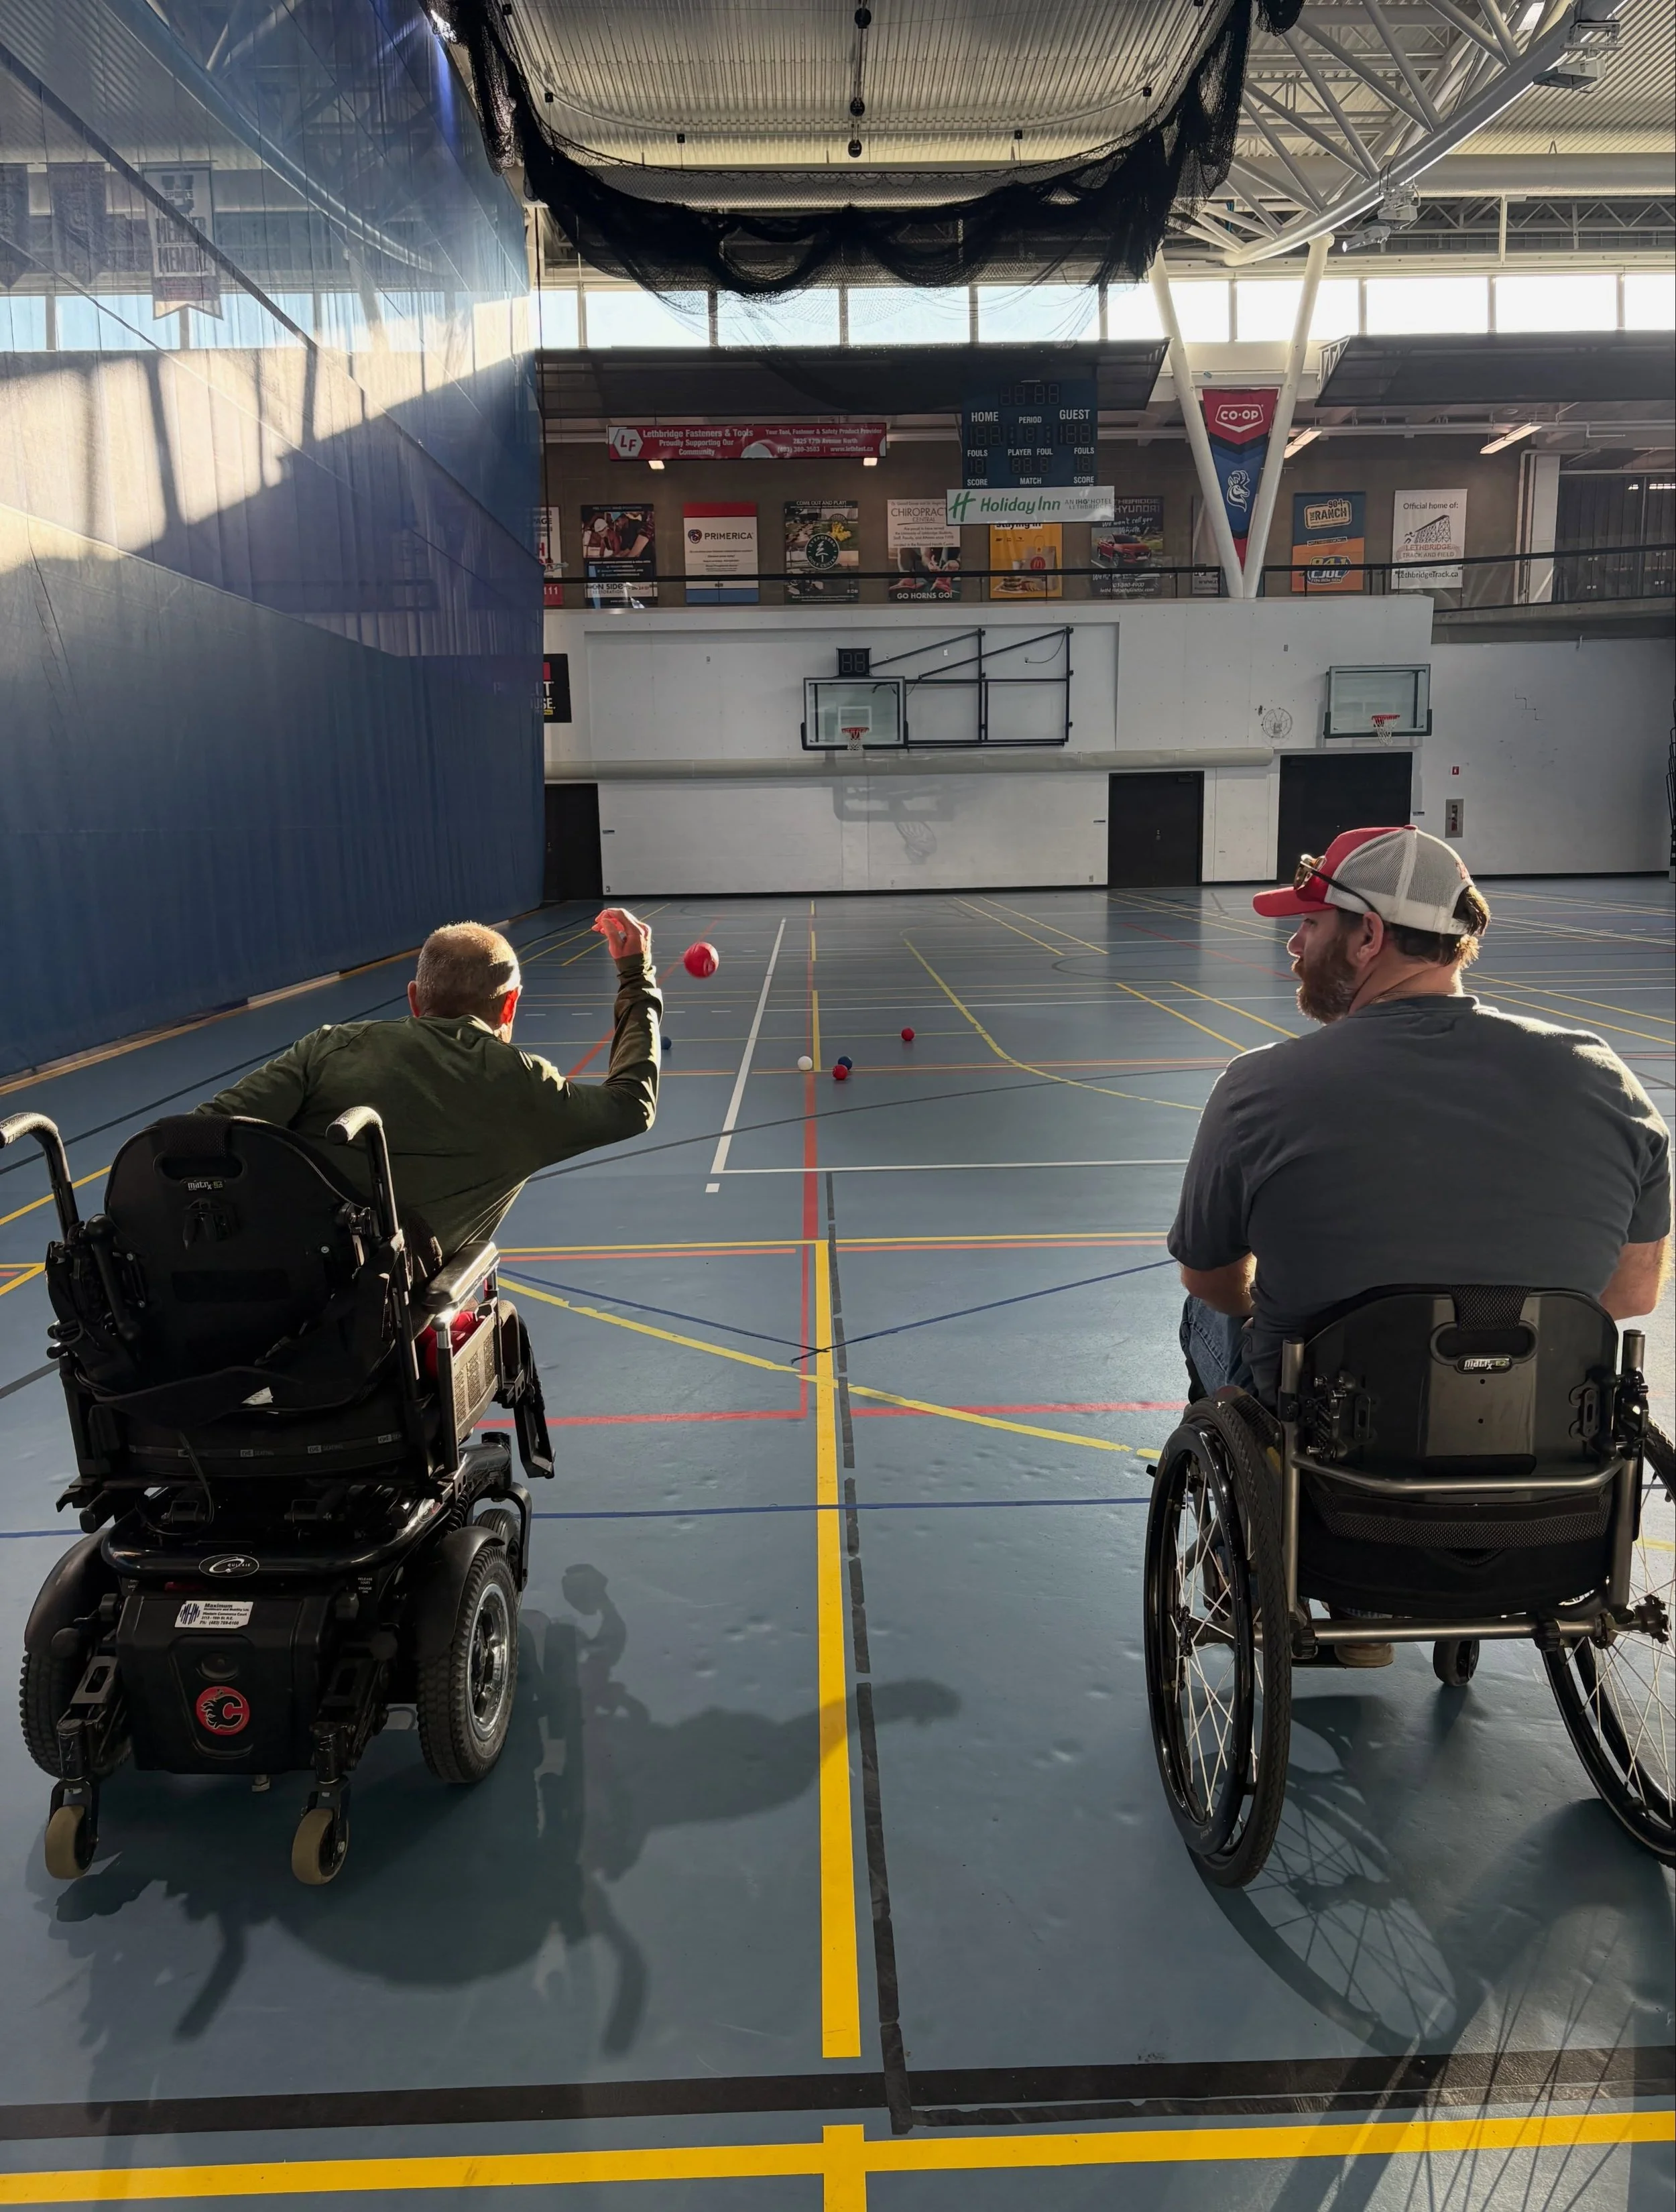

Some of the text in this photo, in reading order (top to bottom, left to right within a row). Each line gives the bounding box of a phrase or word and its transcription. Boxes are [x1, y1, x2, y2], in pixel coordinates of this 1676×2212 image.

[971, 412, 999, 422] HOME
[1059, 410, 1090, 420] GUEST
[643, 430, 683, 439] Lethbridge
[685, 429, 722, 438] Fasteners
[733, 428, 754, 436] Tools
[685, 439, 720, 447] Supporting
[678, 448, 715, 456] Community
[980, 497, 1035, 515] Holiday
[1038, 497, 1060, 511] Inn
[891, 507, 946, 517] CHIROPRAC
[1315, 507, 1347, 520] RANCH
[705, 532, 752, 540] PRIMERICA
